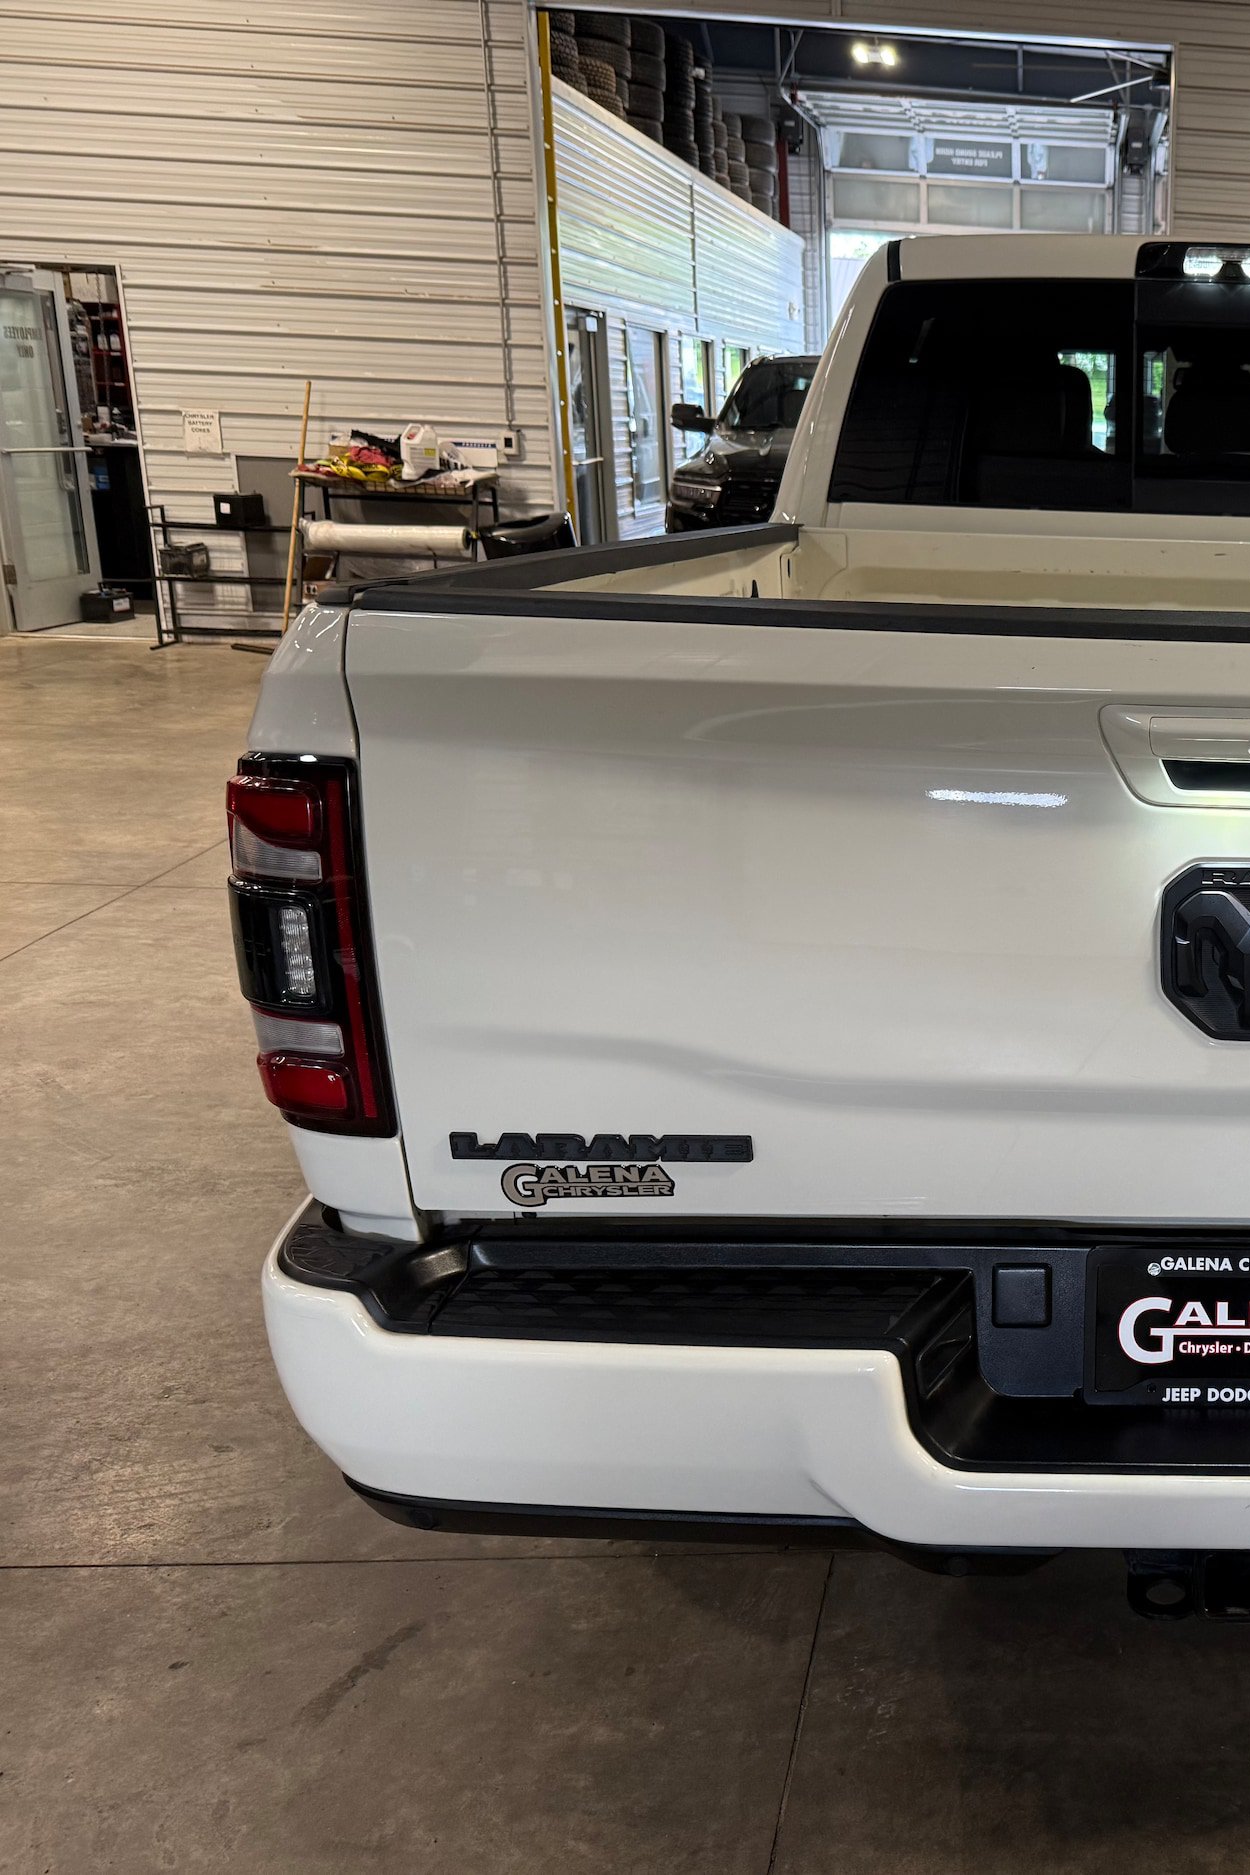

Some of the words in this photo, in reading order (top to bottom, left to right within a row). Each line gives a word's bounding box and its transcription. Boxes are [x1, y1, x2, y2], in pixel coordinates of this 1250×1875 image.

[450, 1131, 753, 1162] LARAMIE
[501, 1163, 674, 1207] GALENA
[541, 1185, 674, 1198] CHRYSLER
[1160, 1257, 1233, 1272] GALENA
[1178, 1341, 1233, 1356] Chrysler
[1162, 1388, 1201, 1402] JEEP
